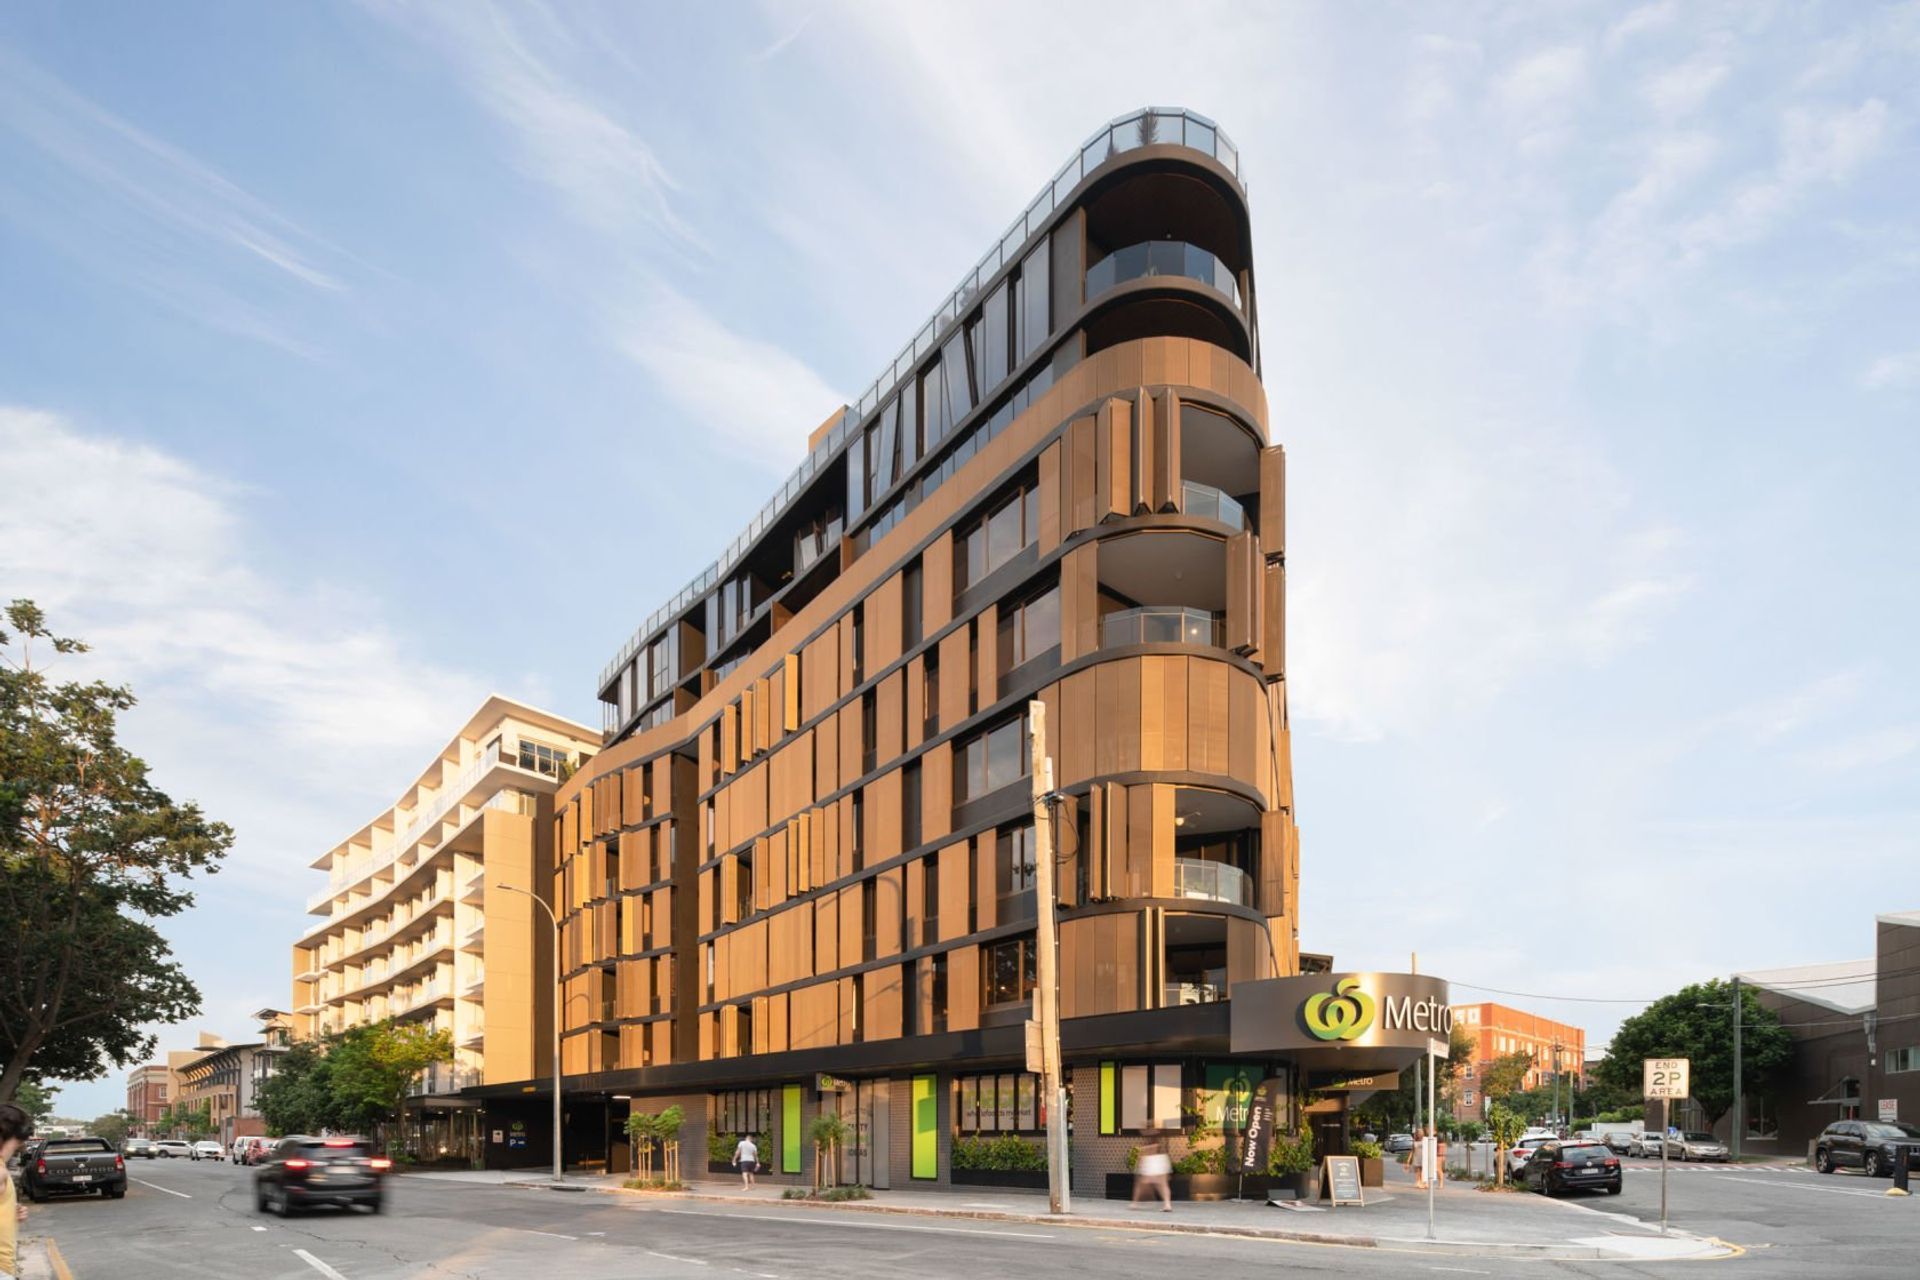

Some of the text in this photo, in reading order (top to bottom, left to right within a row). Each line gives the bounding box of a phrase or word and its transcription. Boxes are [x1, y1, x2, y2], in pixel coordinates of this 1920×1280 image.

[1385, 995, 1453, 1035] Metro
[1652, 1071, 1681, 1086] 2P
[1650, 1087, 1682, 1095] AREA
[1215, 1104, 1249, 1122] Metr
[1248, 1106, 1262, 1139] Open
[1244, 1140, 1257, 1167] Now
